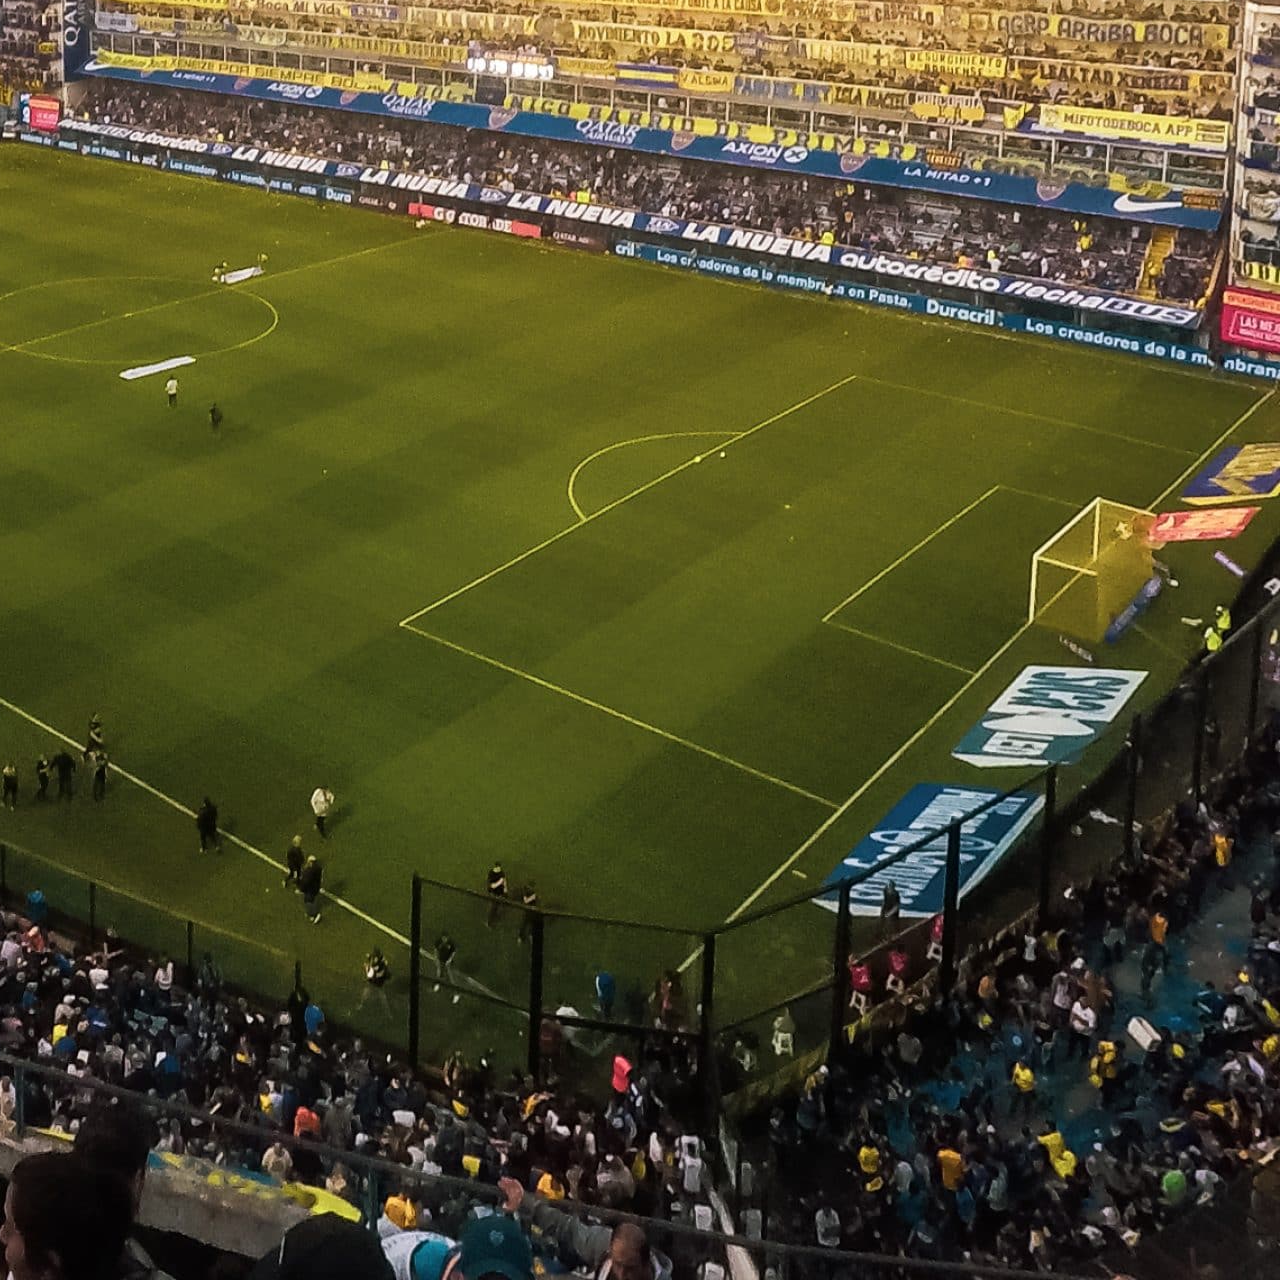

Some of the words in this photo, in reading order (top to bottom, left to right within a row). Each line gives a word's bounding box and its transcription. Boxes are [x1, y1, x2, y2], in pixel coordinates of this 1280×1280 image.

[382, 94, 436, 111] QATAR
[576, 119, 641, 138] QATAR
[722, 141, 784, 158] AXION
[903, 168, 922, 177] LA
[924, 169, 970, 184] MITAD
[326, 187, 352, 203] Dura
[232, 146, 260, 162] LA
[259, 150, 328, 174] NUEVA
[359, 167, 391, 185] LA
[391, 173, 470, 199] NUEVA
[507, 192, 542, 212] LA
[544, 199, 636, 228] NUEVA
[682, 222, 721, 243] LA
[726, 228, 832, 263] NUEVA
[657, 249, 677, 265] Los
[680, 253, 740, 275] cradores
[742, 265, 758, 279] de
[761, 268, 773, 282] la
[848, 286, 865, 299] en
[926, 298, 995, 326] Duracril
[1026, 318, 1054, 335] Los
[1058, 326, 1140, 352] creadores
[1144, 342, 1166, 357] de
[1170, 345, 1186, 360] la
